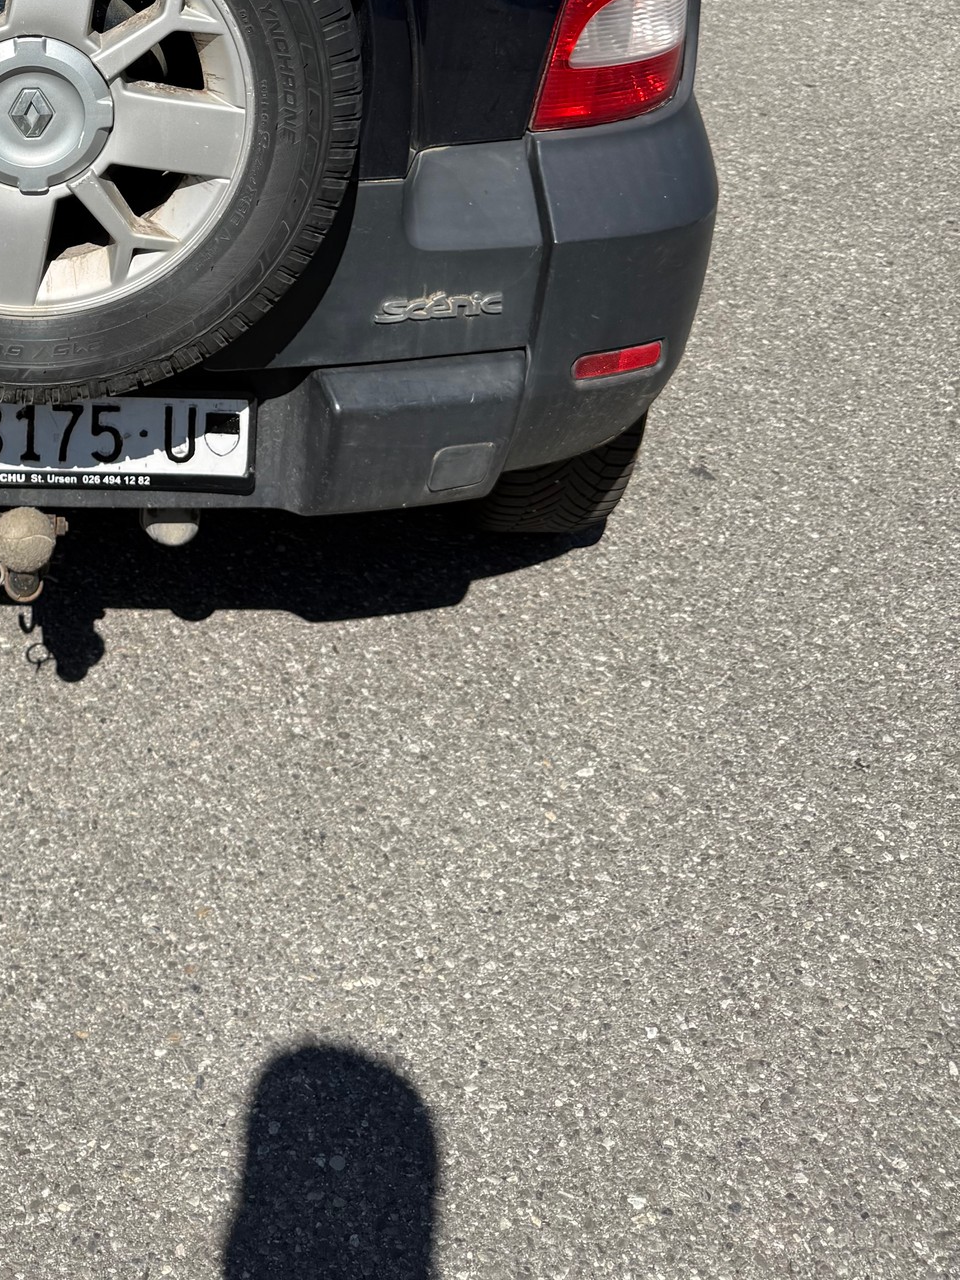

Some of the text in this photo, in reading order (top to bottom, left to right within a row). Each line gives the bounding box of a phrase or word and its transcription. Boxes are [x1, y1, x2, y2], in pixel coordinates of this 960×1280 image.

[30, 474, 45, 483] St.
[46, 474, 78, 484] Ursen
[82, 475, 101, 484] 026
[102, 475, 121, 484] 494
[123, 476, 136, 485] 12
[137, 476, 151, 485] 82
